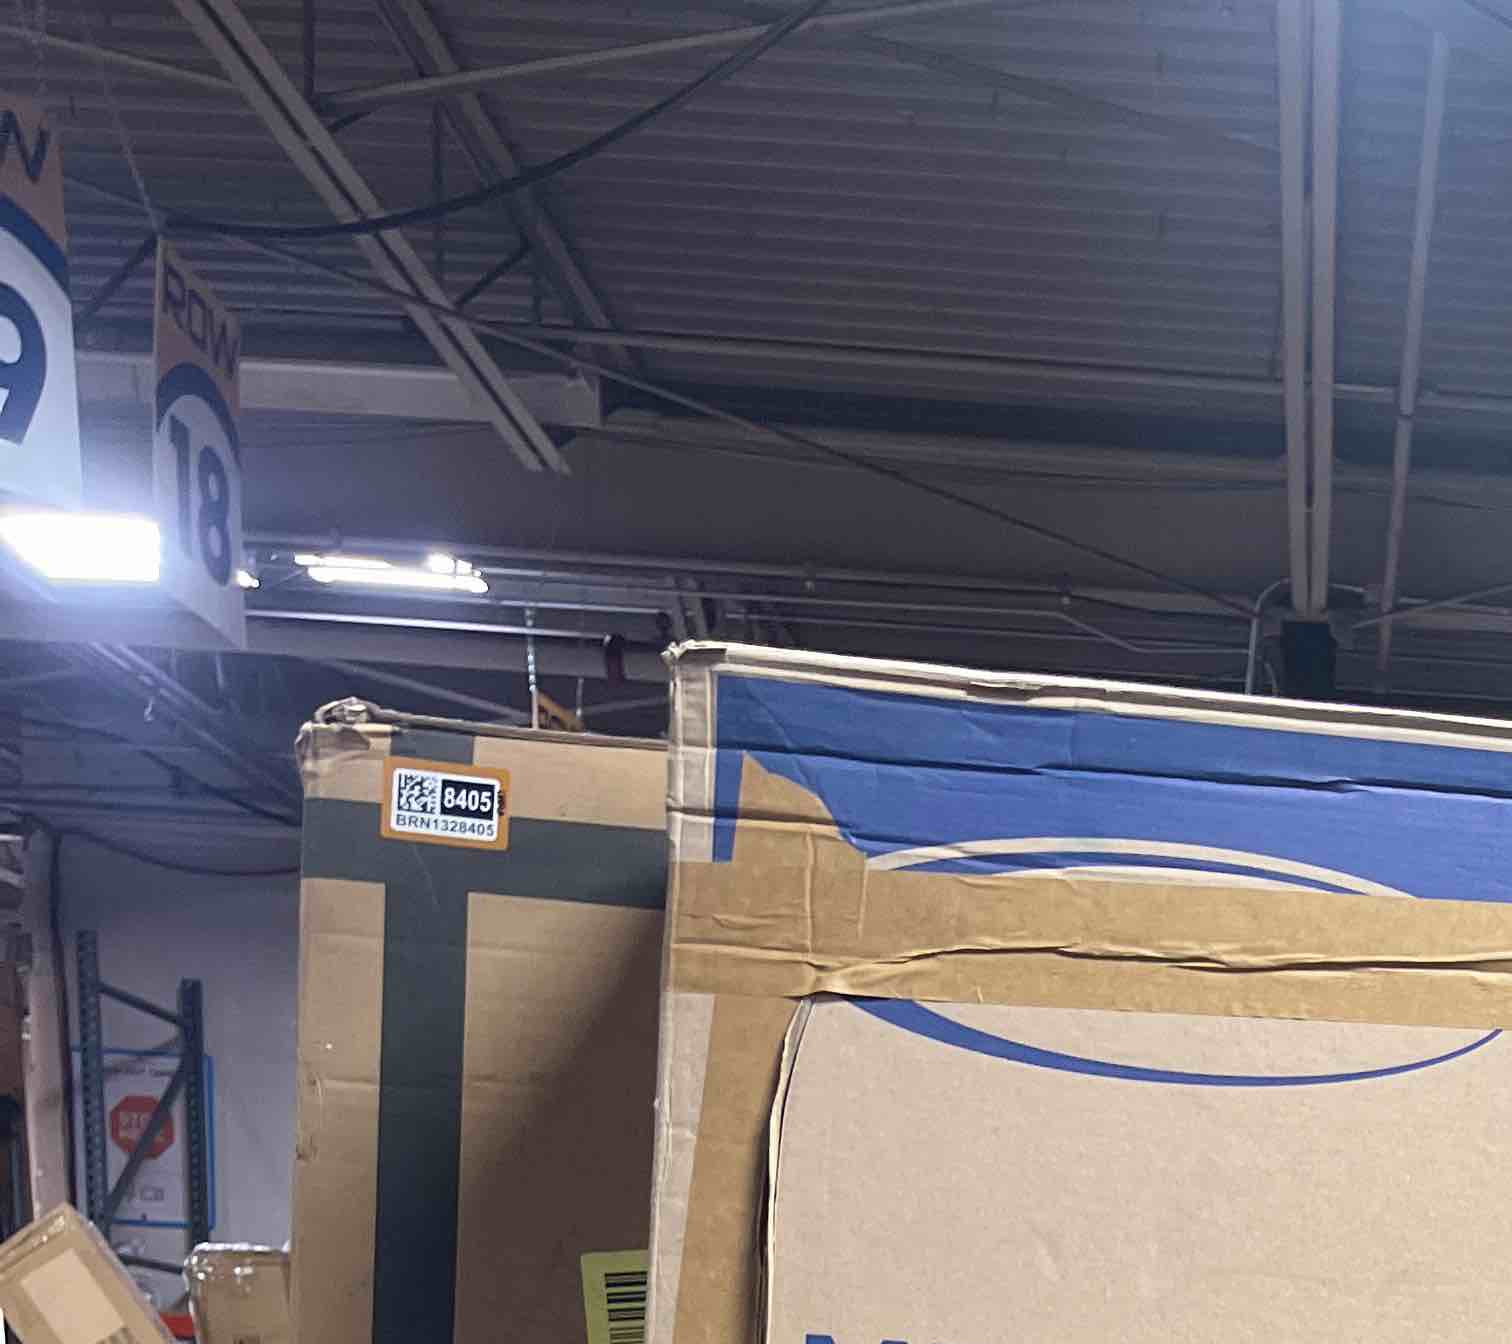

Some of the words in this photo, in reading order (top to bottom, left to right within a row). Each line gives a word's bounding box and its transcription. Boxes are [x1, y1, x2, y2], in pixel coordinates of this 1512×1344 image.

[165, 266, 240, 377] ROW
[169, 414, 231, 586] 18
[396, 814, 494, 837] BRN1328405
[443, 787, 492, 812] 8405
